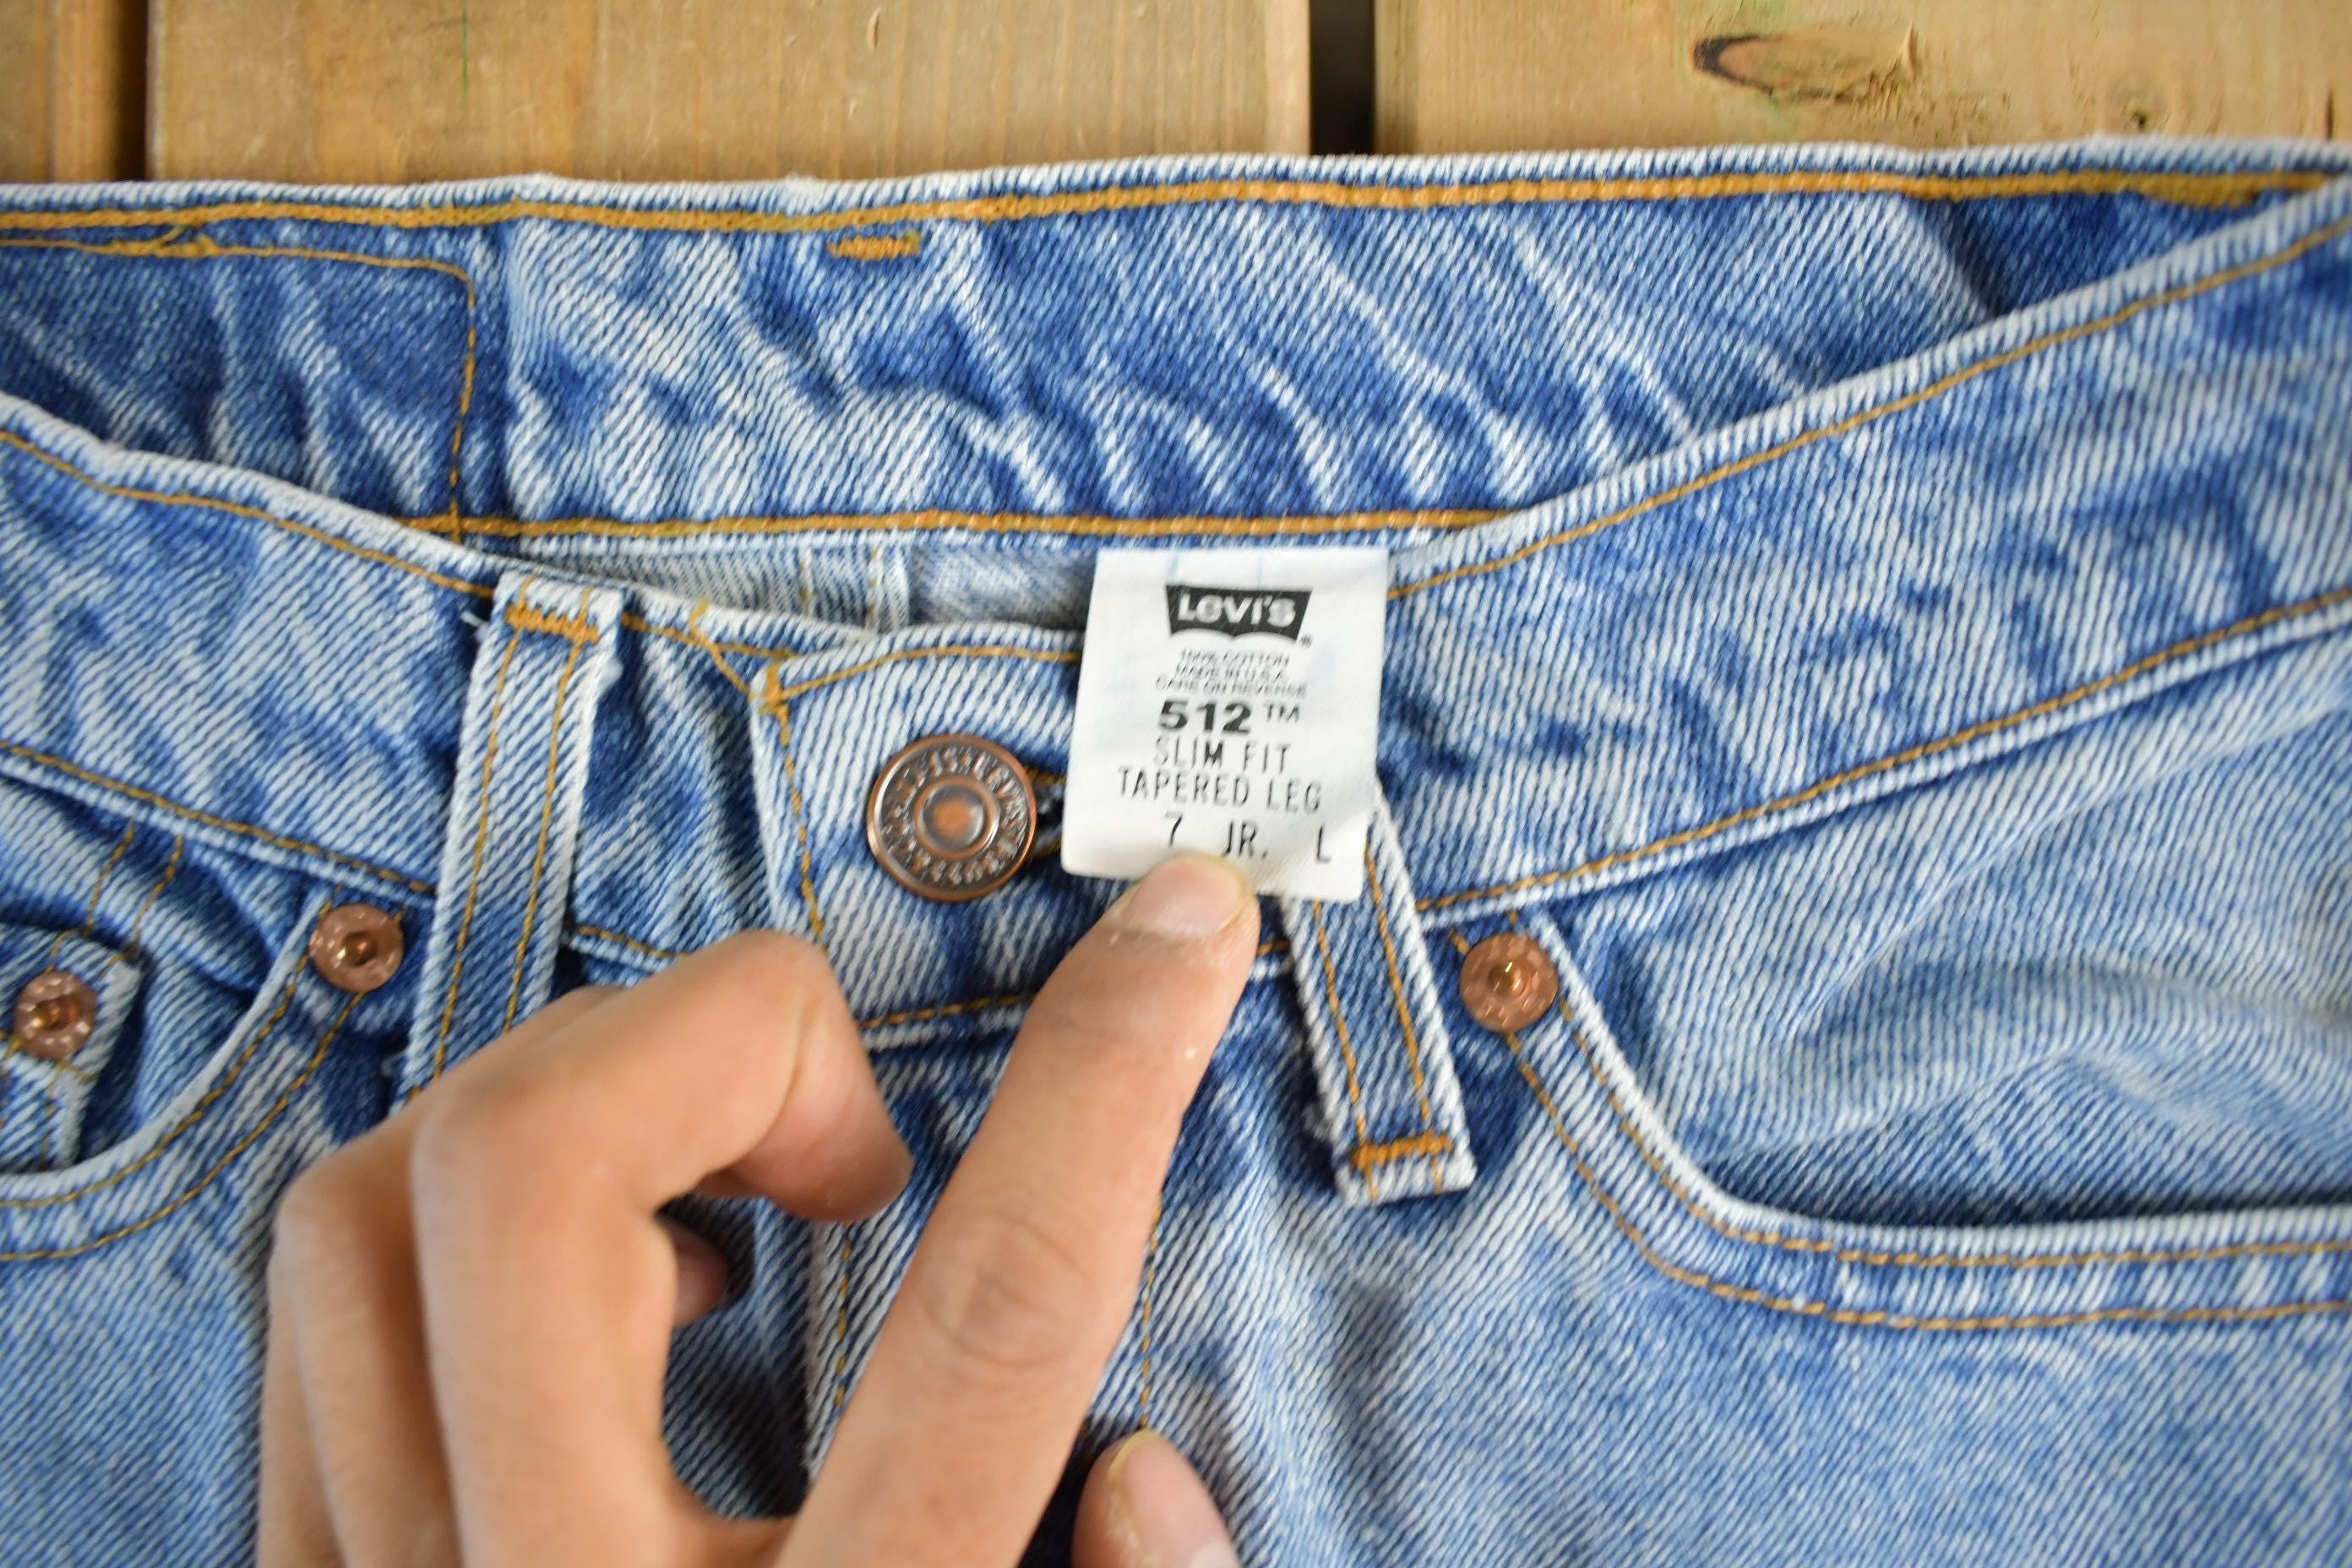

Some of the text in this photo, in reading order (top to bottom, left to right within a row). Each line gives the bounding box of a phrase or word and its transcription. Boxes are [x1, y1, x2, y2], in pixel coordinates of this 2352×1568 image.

[1158, 700, 1254, 734] 512
[1154, 736, 1291, 775] SLIM FIT
[1119, 765, 1322, 814] TAPERED LEG
[1164, 812, 1331, 863] 7 JR. L
